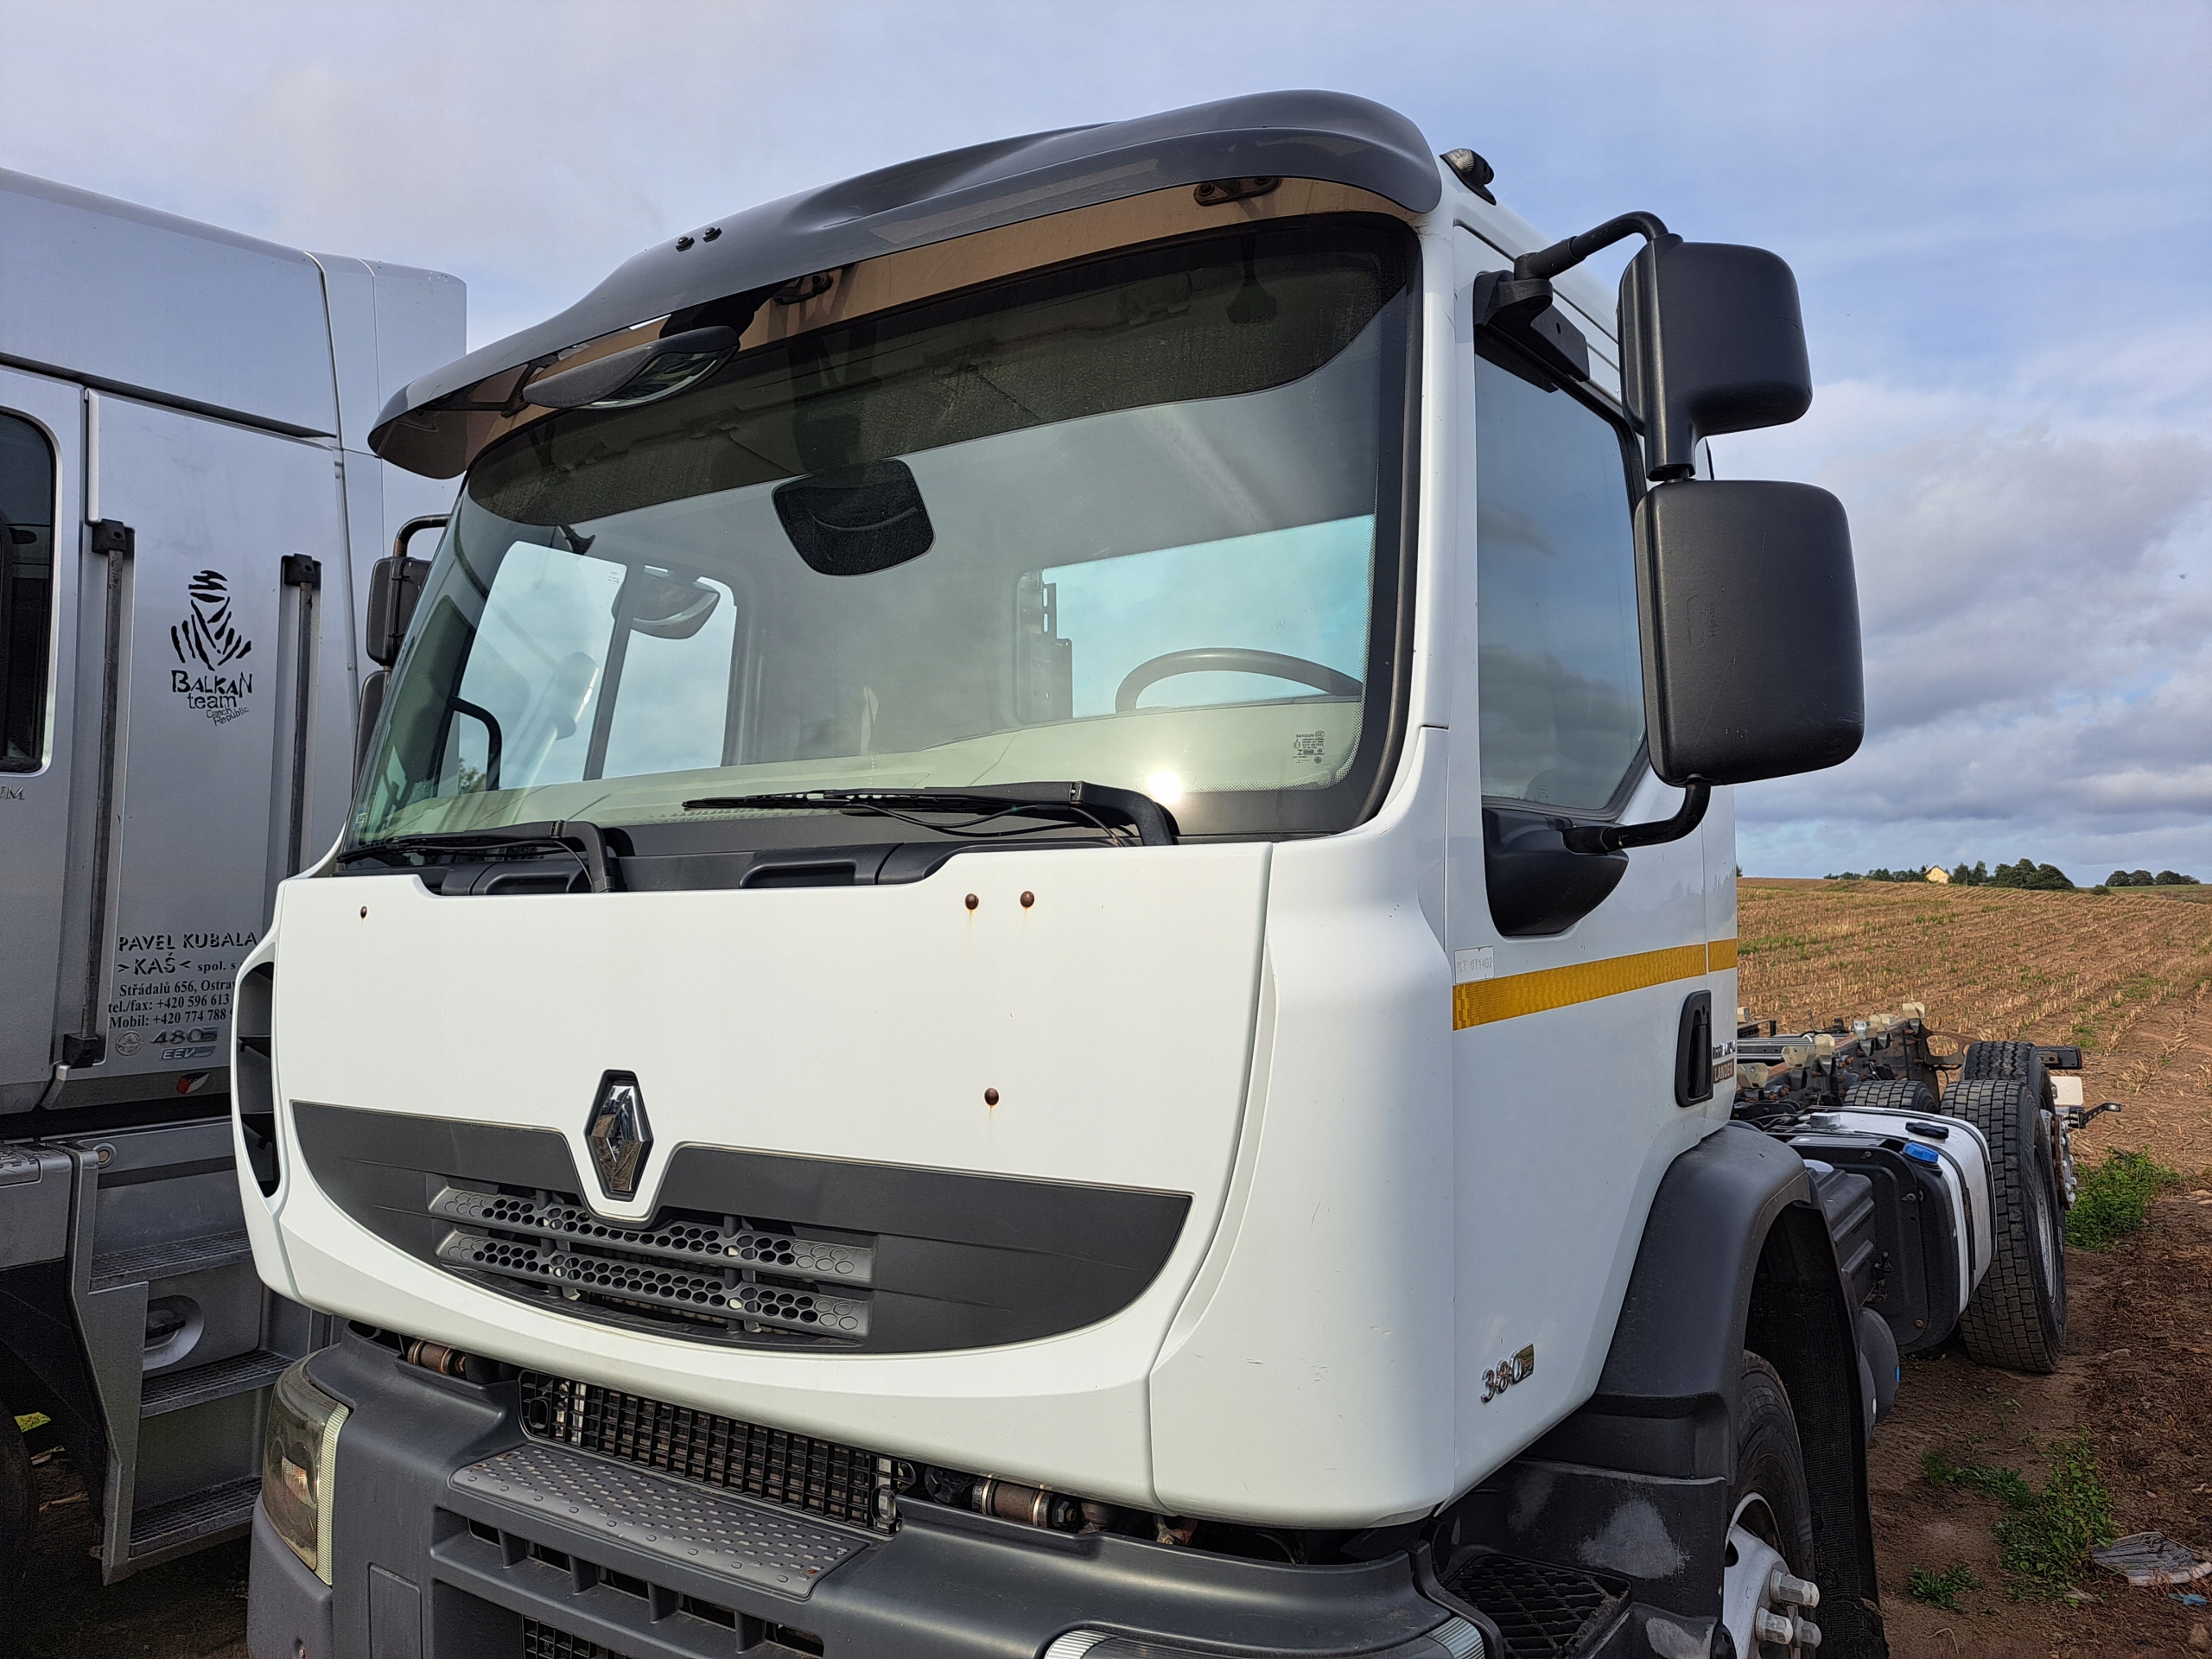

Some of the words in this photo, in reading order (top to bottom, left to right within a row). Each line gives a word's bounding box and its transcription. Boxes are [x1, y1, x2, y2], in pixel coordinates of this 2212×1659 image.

[171, 670, 252, 698] BALKAN
[187, 693, 237, 709] team
[207, 704, 233, 718] Czech
[213, 707, 250, 727] Republic
[118, 934, 175, 951] PAVEL
[183, 931, 258, 950] KUBALA
[197, 961, 226, 975] spol.
[230, 962, 237, 970] s
[119, 981, 171, 997] Střádalů
[174, 980, 197, 994] 656,
[108, 1000, 153, 1014] tel./fax:
[156, 995, 184, 1009] +420
[188, 994, 207, 1007] 596
[210, 993, 230, 1006] 613
[109, 1014, 149, 1029] Mobil:
[153, 1011, 181, 1025] +420
[185, 1010, 204, 1023] 774
[207, 1007, 226, 1021] 788
[151, 1027, 206, 1045] 480
[162, 1047, 196, 1059] EEV
[1714, 1061, 1733, 1082] LANDER
[1480, 1351, 1523, 1404] 380
